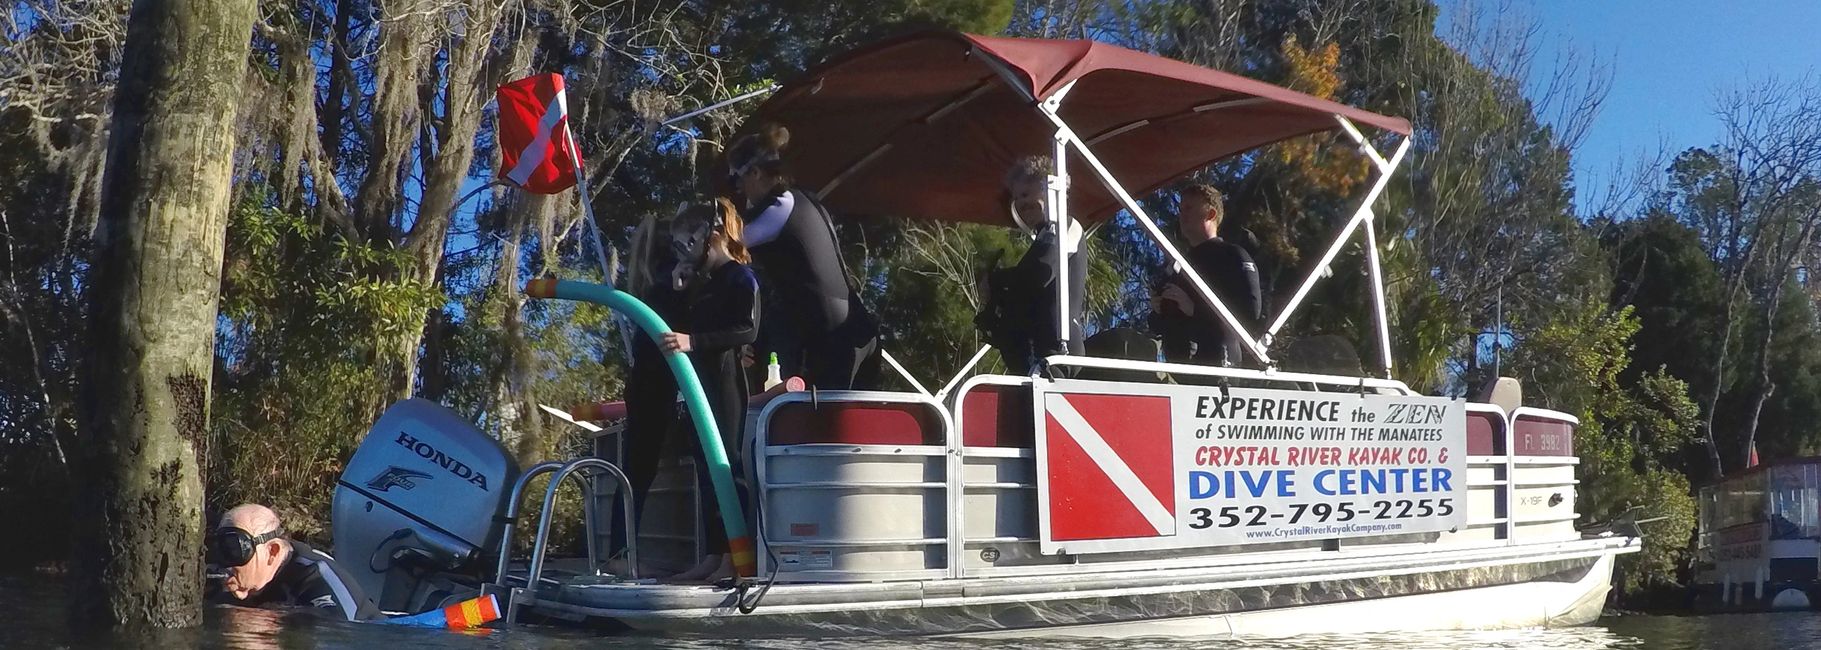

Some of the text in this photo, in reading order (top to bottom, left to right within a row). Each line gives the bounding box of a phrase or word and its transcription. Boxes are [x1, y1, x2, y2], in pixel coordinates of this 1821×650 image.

[1195, 396, 1447, 424] EXPERIENCE the ZEN
[1195, 423, 1443, 441] of SWIMMING WITH THE MANATEES
[394, 431, 489, 492] HONDA
[1195, 446, 1449, 467] CRYSTAL RIVER KAYAK CO. &
[1189, 467, 1453, 499] DIVE CENTER
[1189, 498, 1453, 529] 352-795-2255
[1246, 523, 1402, 539] www.CrystalRiverKayakCompany.com
